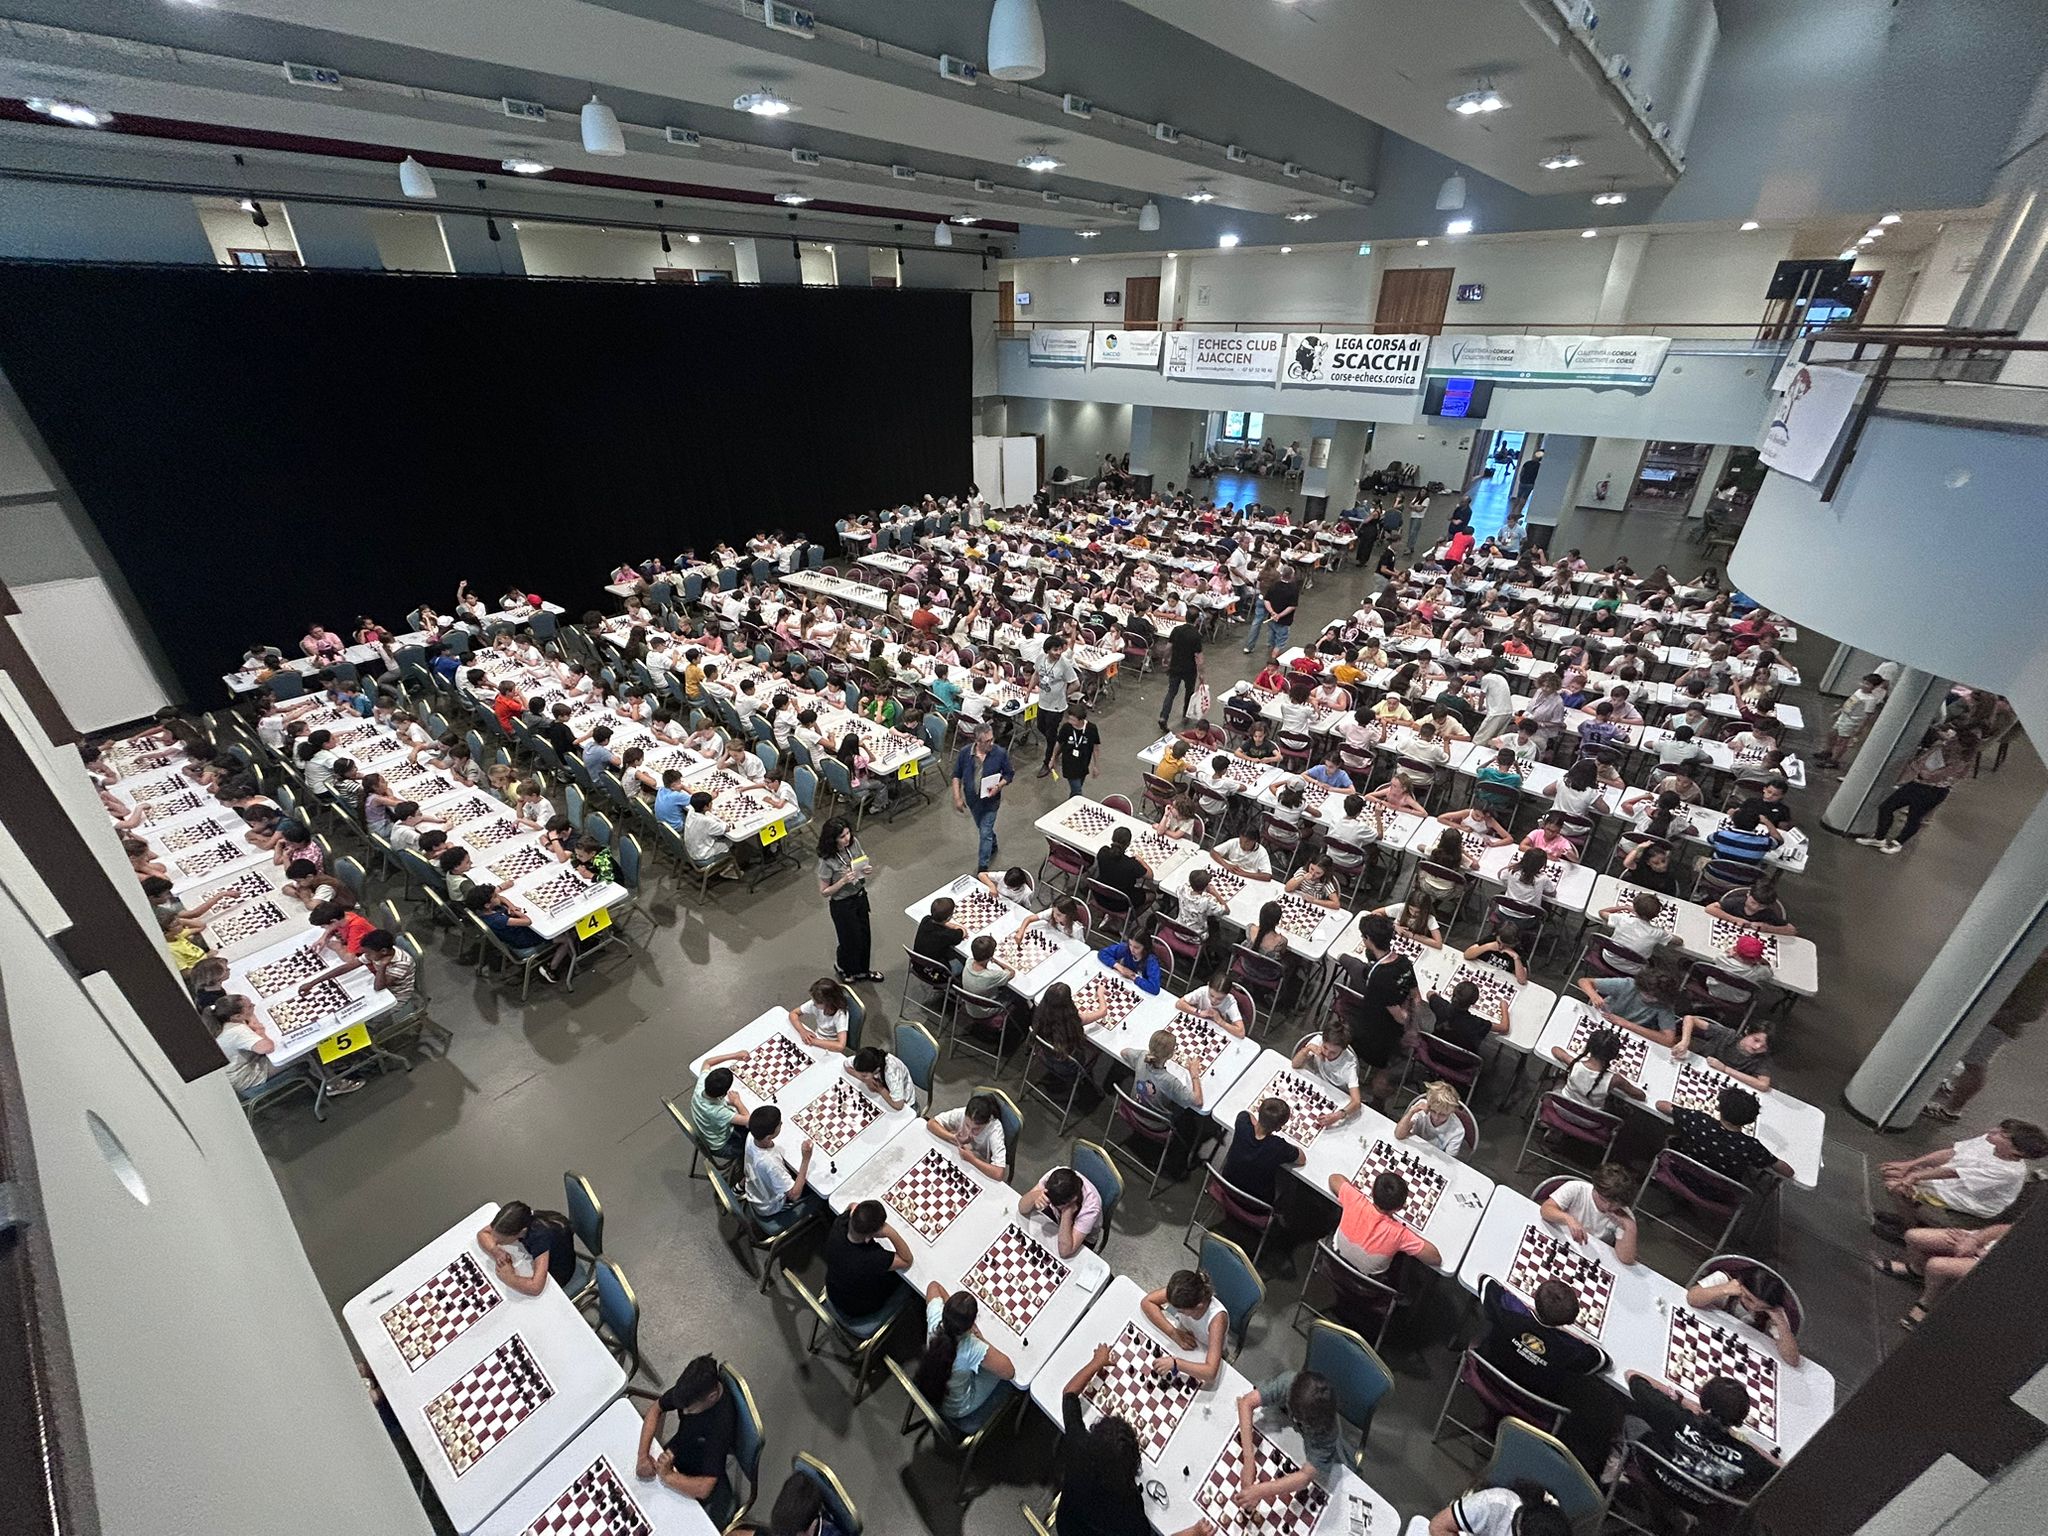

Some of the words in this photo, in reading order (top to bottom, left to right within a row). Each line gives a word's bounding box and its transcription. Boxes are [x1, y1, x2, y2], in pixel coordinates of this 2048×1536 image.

[1198, 338, 1242, 350] ECHECS
[1246, 340, 1277, 351] CLUB
[1335, 338, 1363, 350] LEGA
[1366, 338, 1406, 351] CORSA
[1409, 340, 1420, 351] di
[1197, 352, 1252, 364] AJACCIEN
[1332, 353, 1420, 371] SCACCHI
[1331, 371, 1416, 384] corse-echecs.corsica
[905, 763, 911, 775] 2
[768, 825, 777, 837] 3
[588, 914, 599, 928] 4
[336, 1032, 352, 1050] 5
